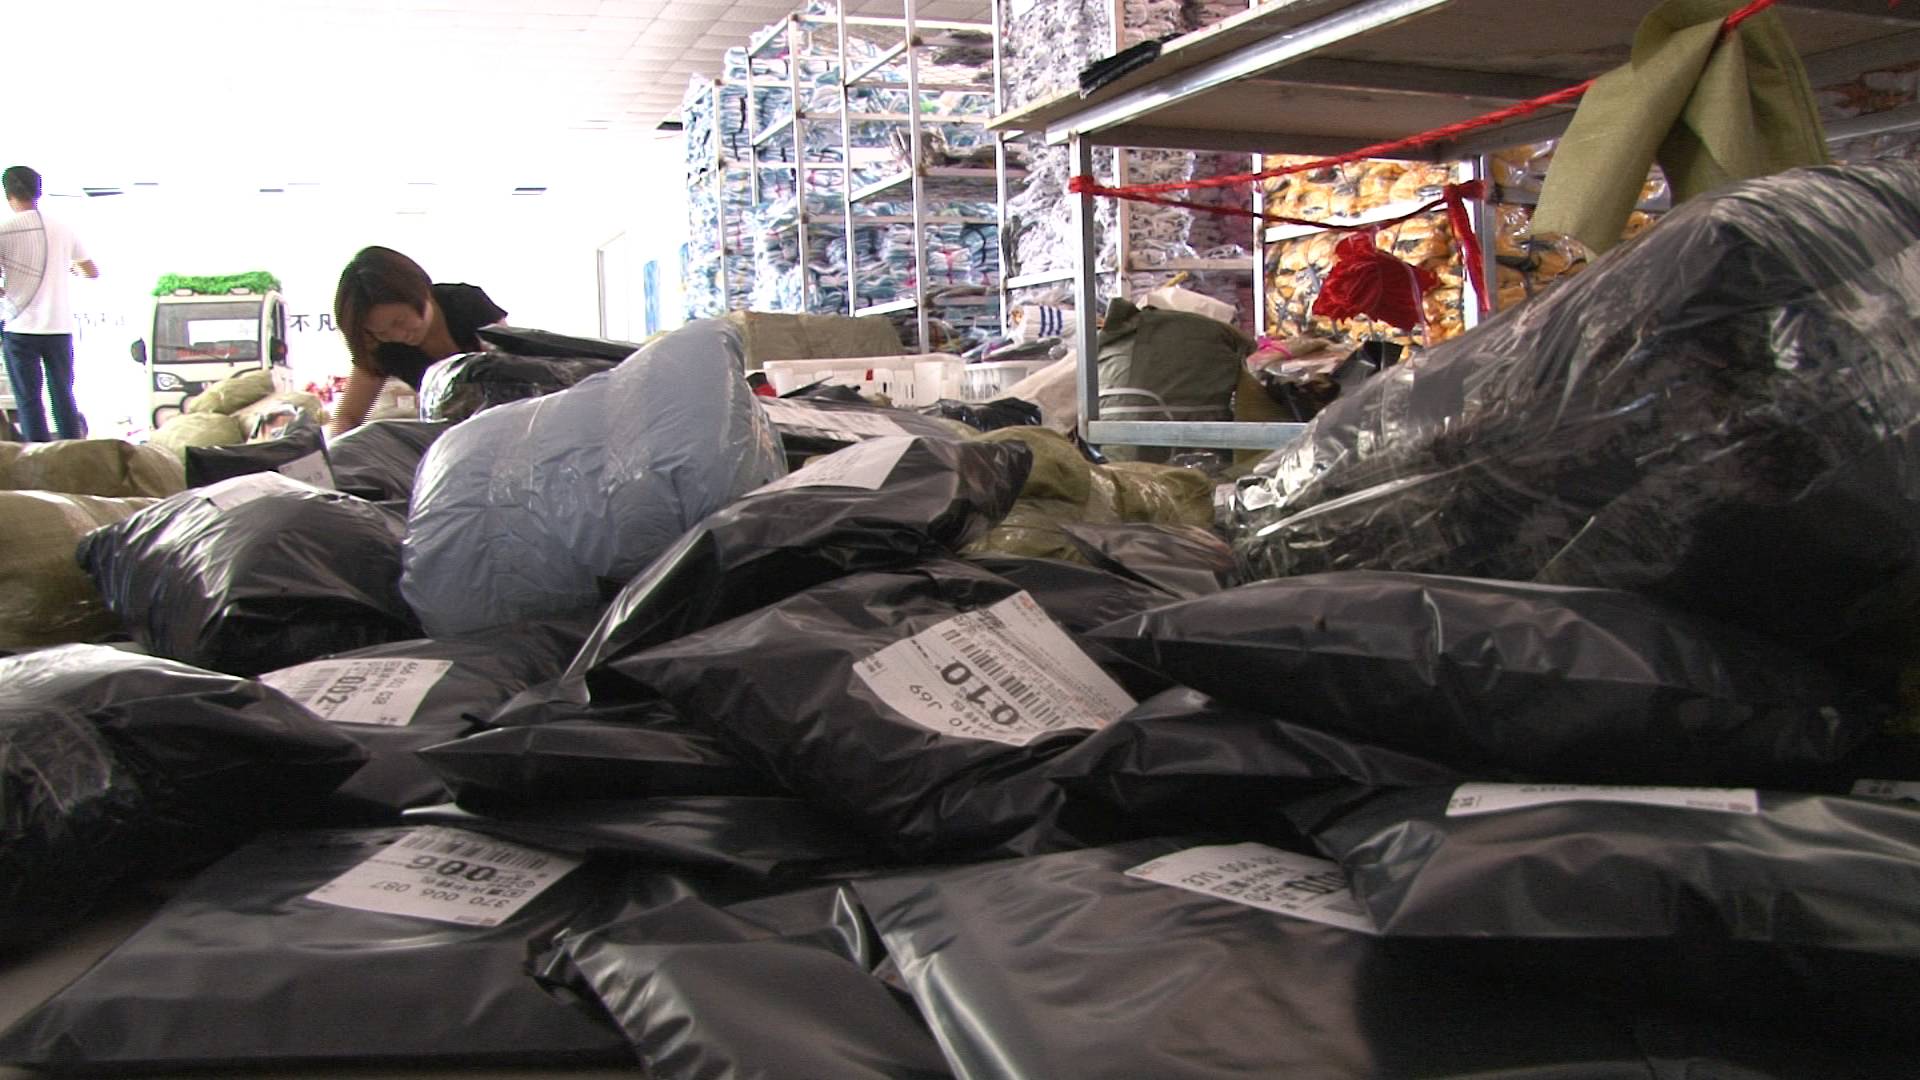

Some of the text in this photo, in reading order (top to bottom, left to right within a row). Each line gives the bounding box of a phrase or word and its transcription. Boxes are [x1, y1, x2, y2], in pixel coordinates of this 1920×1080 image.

[316, 676, 366, 705] 002
[908, 685, 943, 710] J69
[940, 661, 1020, 727] 010
[405, 855, 497, 882] 006
[369, 881, 411, 894] 087
[422, 888, 460, 902] 006
[469, 896, 510, 909] 370
